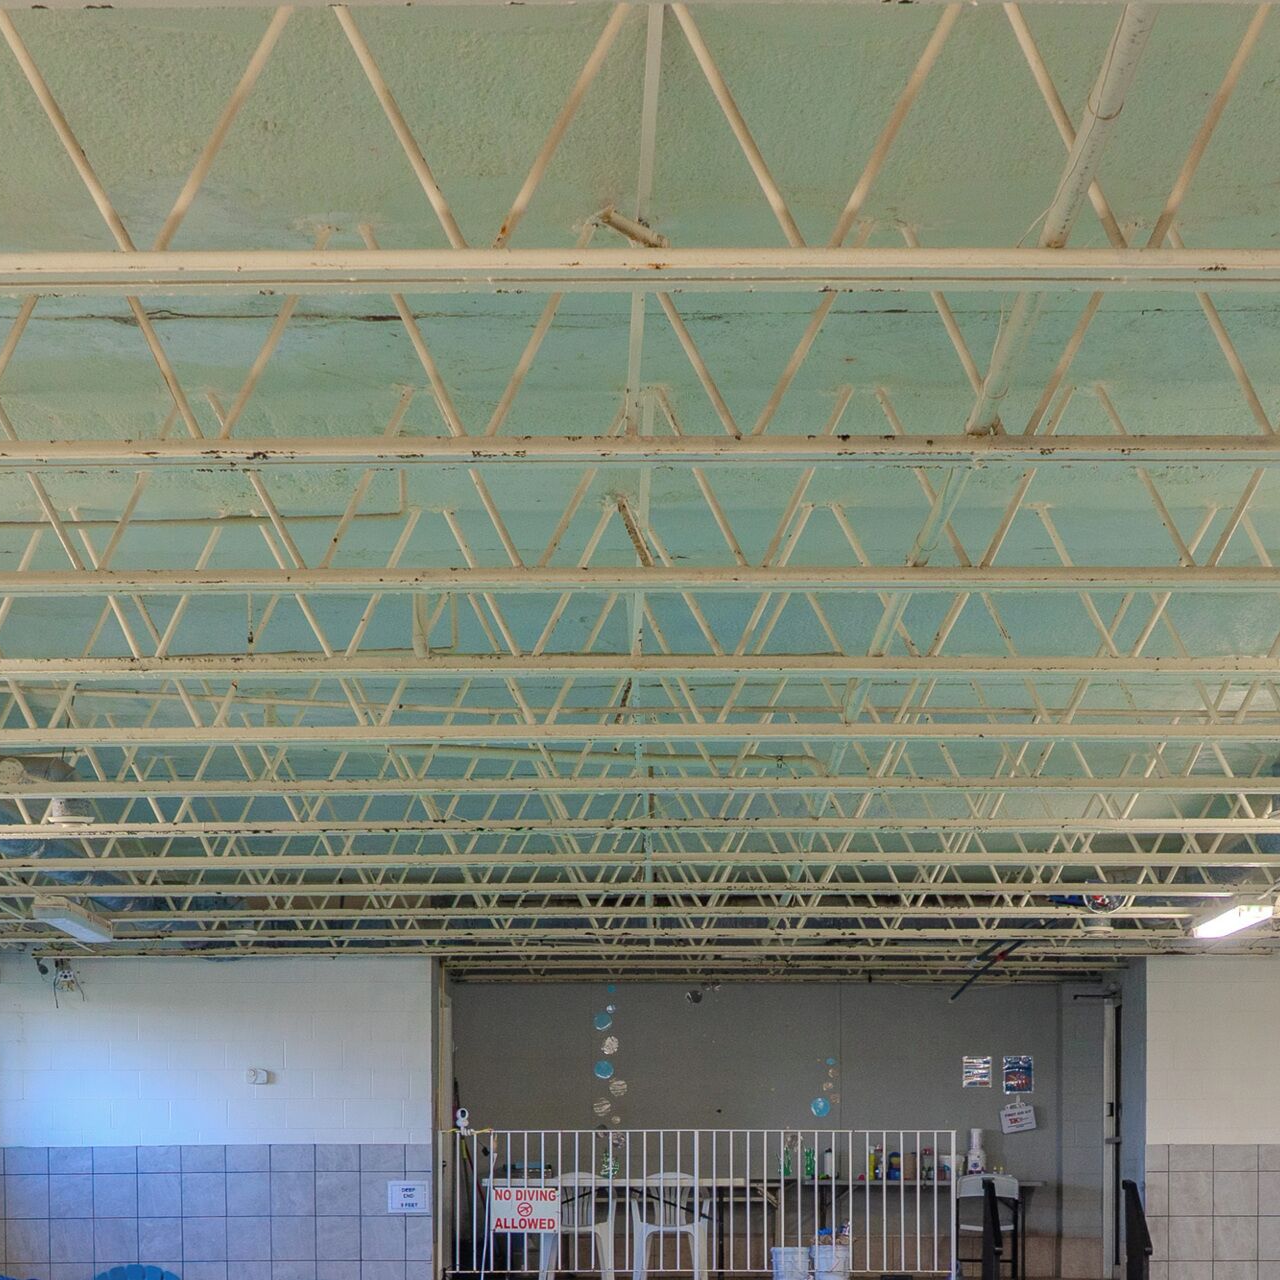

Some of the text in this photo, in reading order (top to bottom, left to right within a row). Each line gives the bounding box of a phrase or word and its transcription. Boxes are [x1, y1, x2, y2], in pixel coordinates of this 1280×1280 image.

[494, 1189, 557, 1201] NO DIVING
[495, 1218, 556, 1230] ALLOWED
